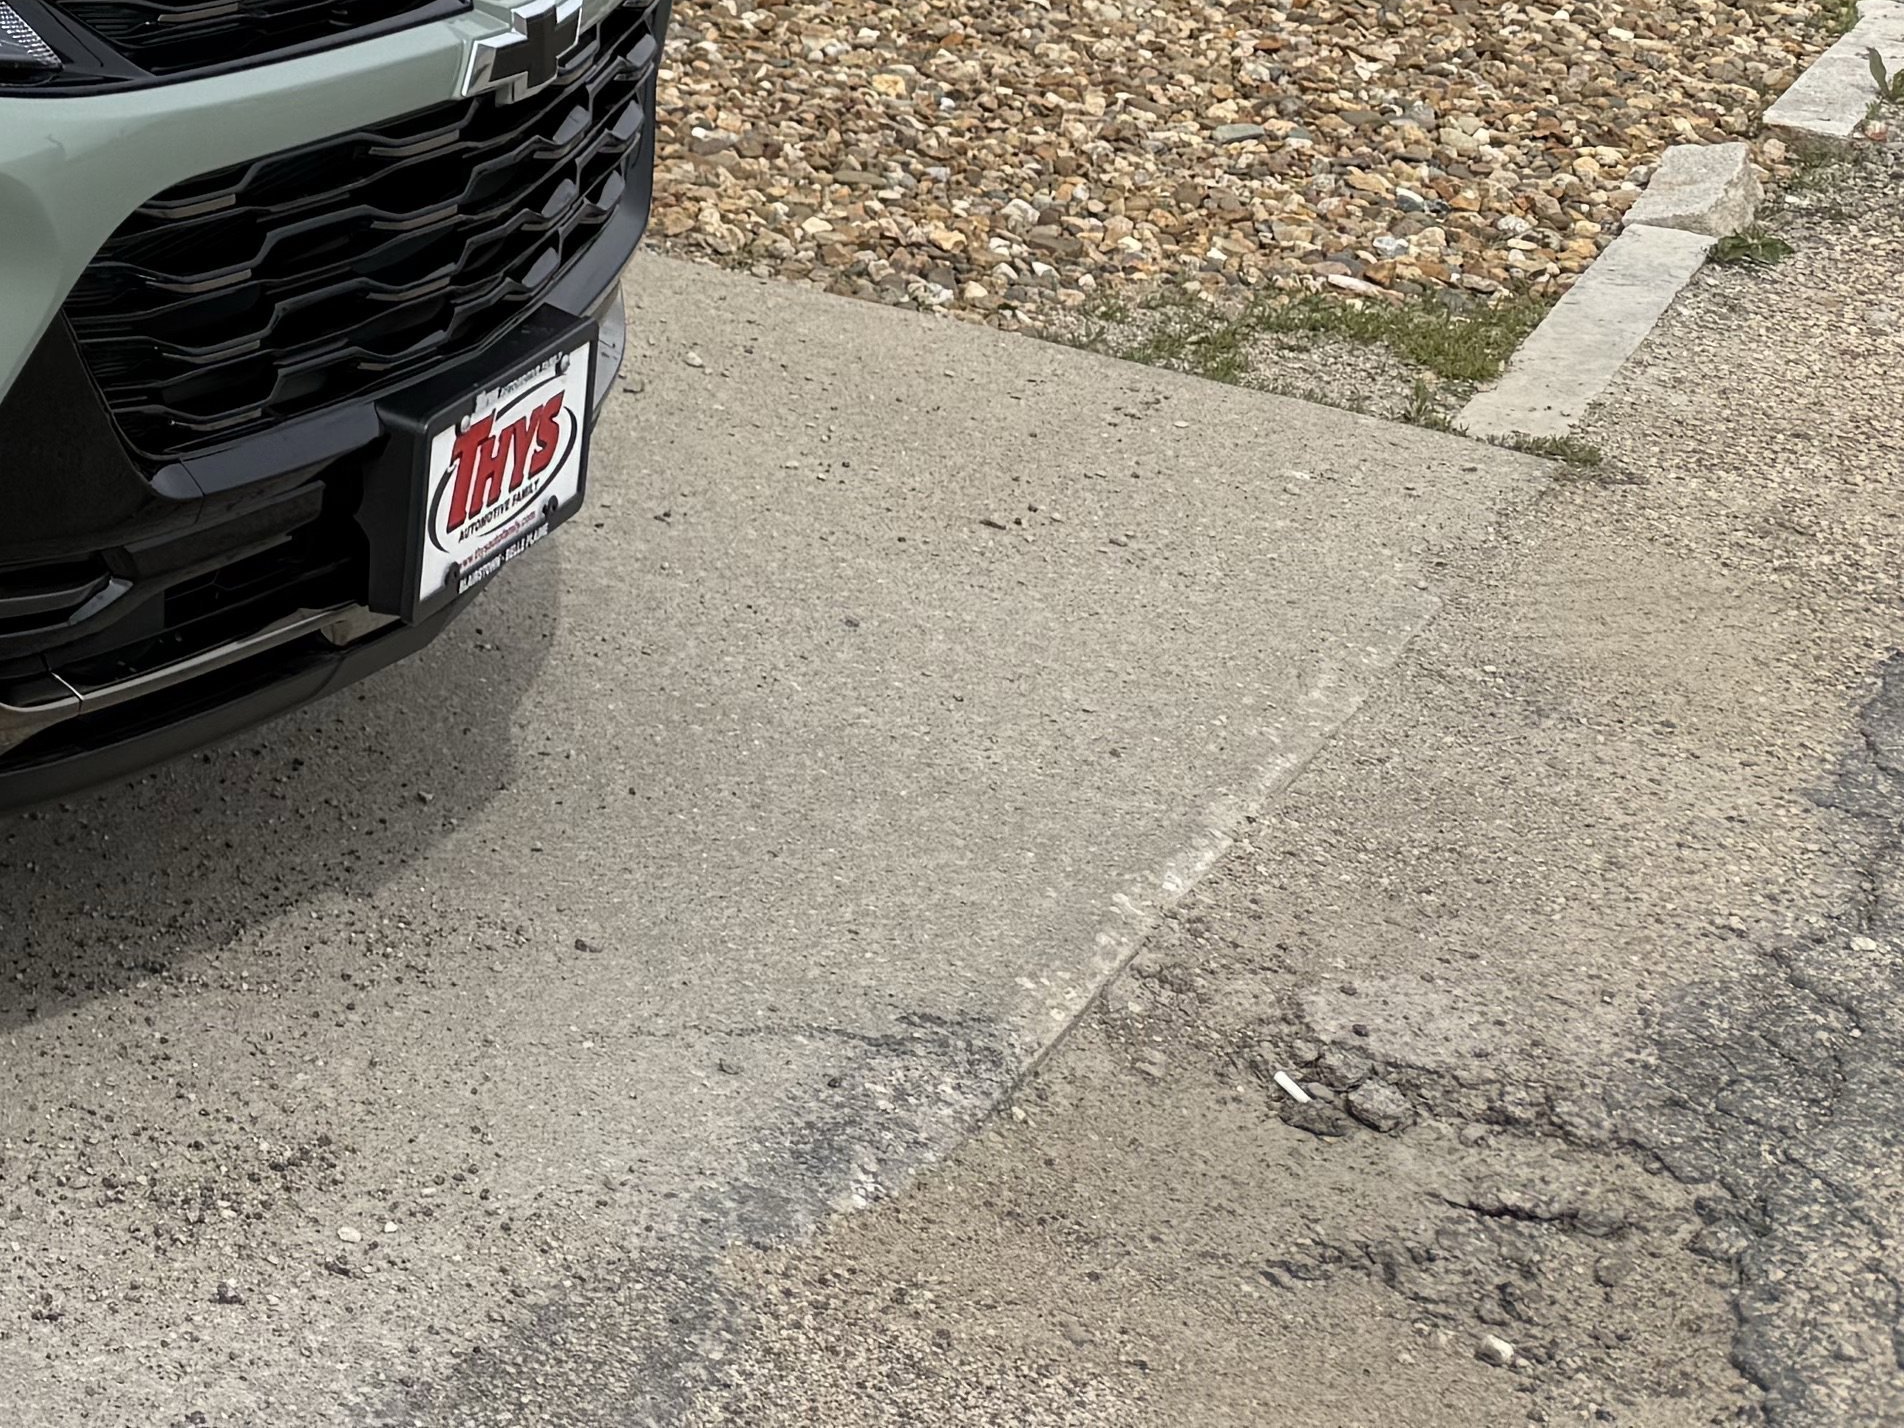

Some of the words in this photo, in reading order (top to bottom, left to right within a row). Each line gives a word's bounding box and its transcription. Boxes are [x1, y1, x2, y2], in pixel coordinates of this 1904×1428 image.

[447, 390, 565, 534] THYS
[458, 498, 510, 543] AUTOMOTIVE
[511, 477, 540, 512] FAMILY
